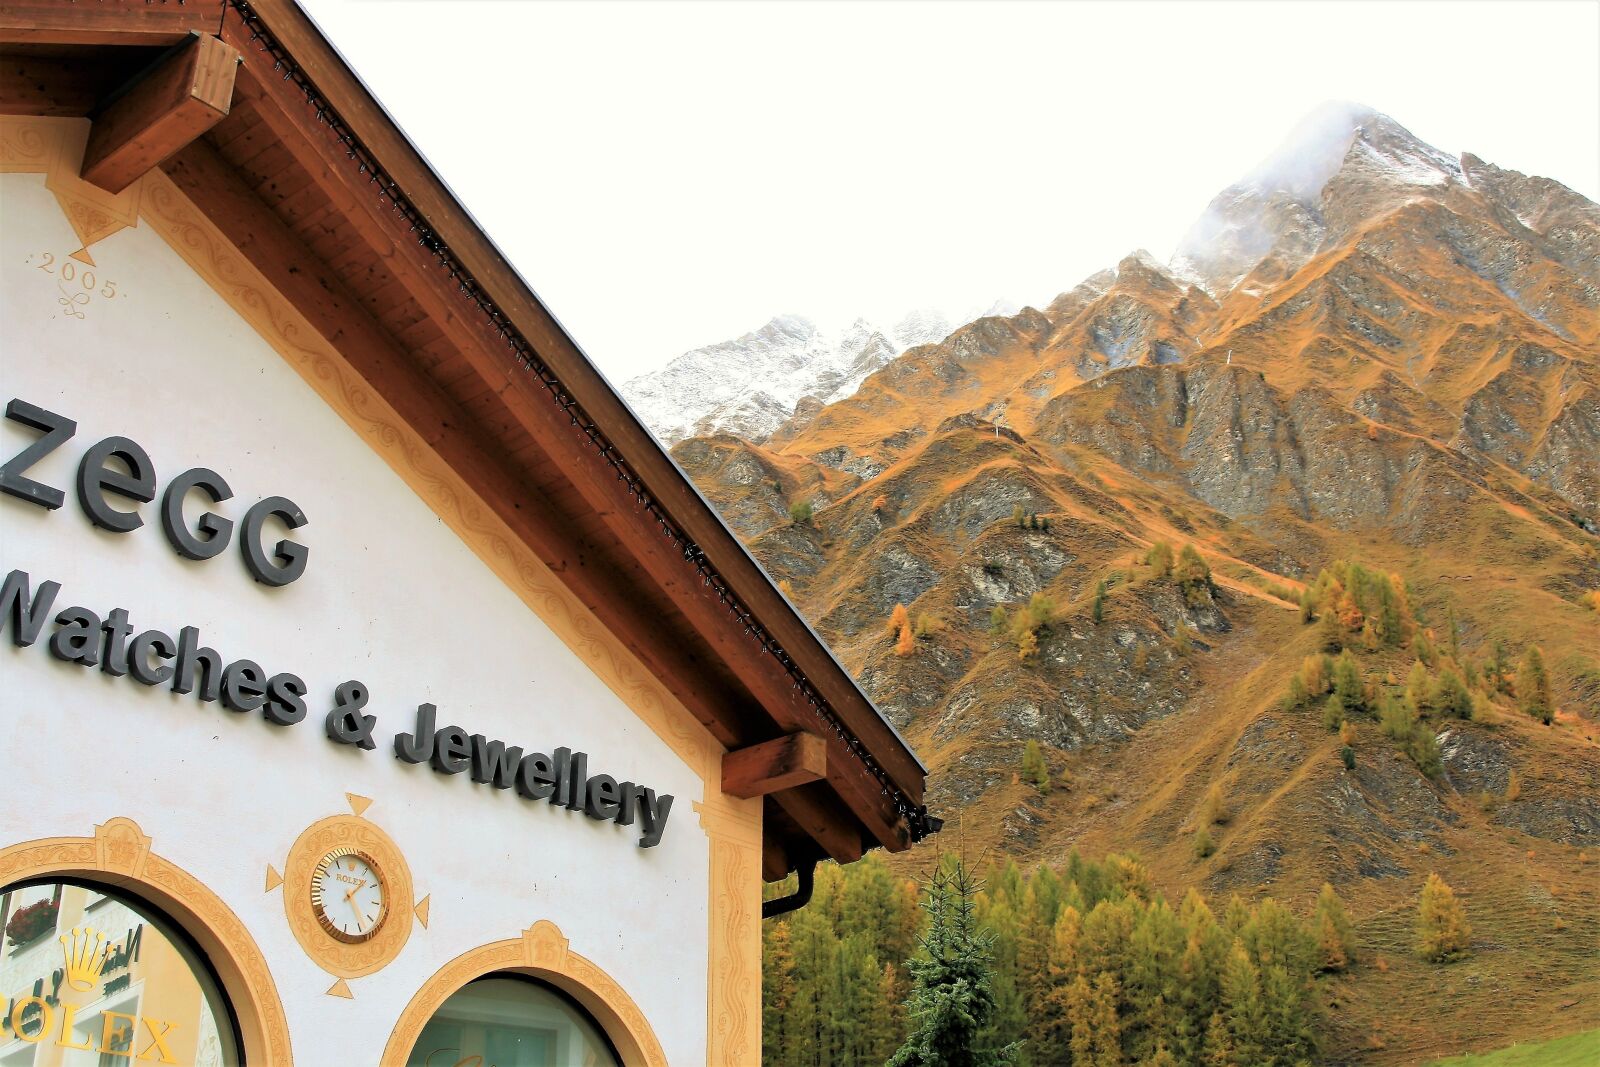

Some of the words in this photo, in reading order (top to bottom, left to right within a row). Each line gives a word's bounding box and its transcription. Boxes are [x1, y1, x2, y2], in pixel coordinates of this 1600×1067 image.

[326, 680, 377, 750] &
[395, 703, 674, 848] Jewellery
[0, 994, 180, 1064] OLEX
